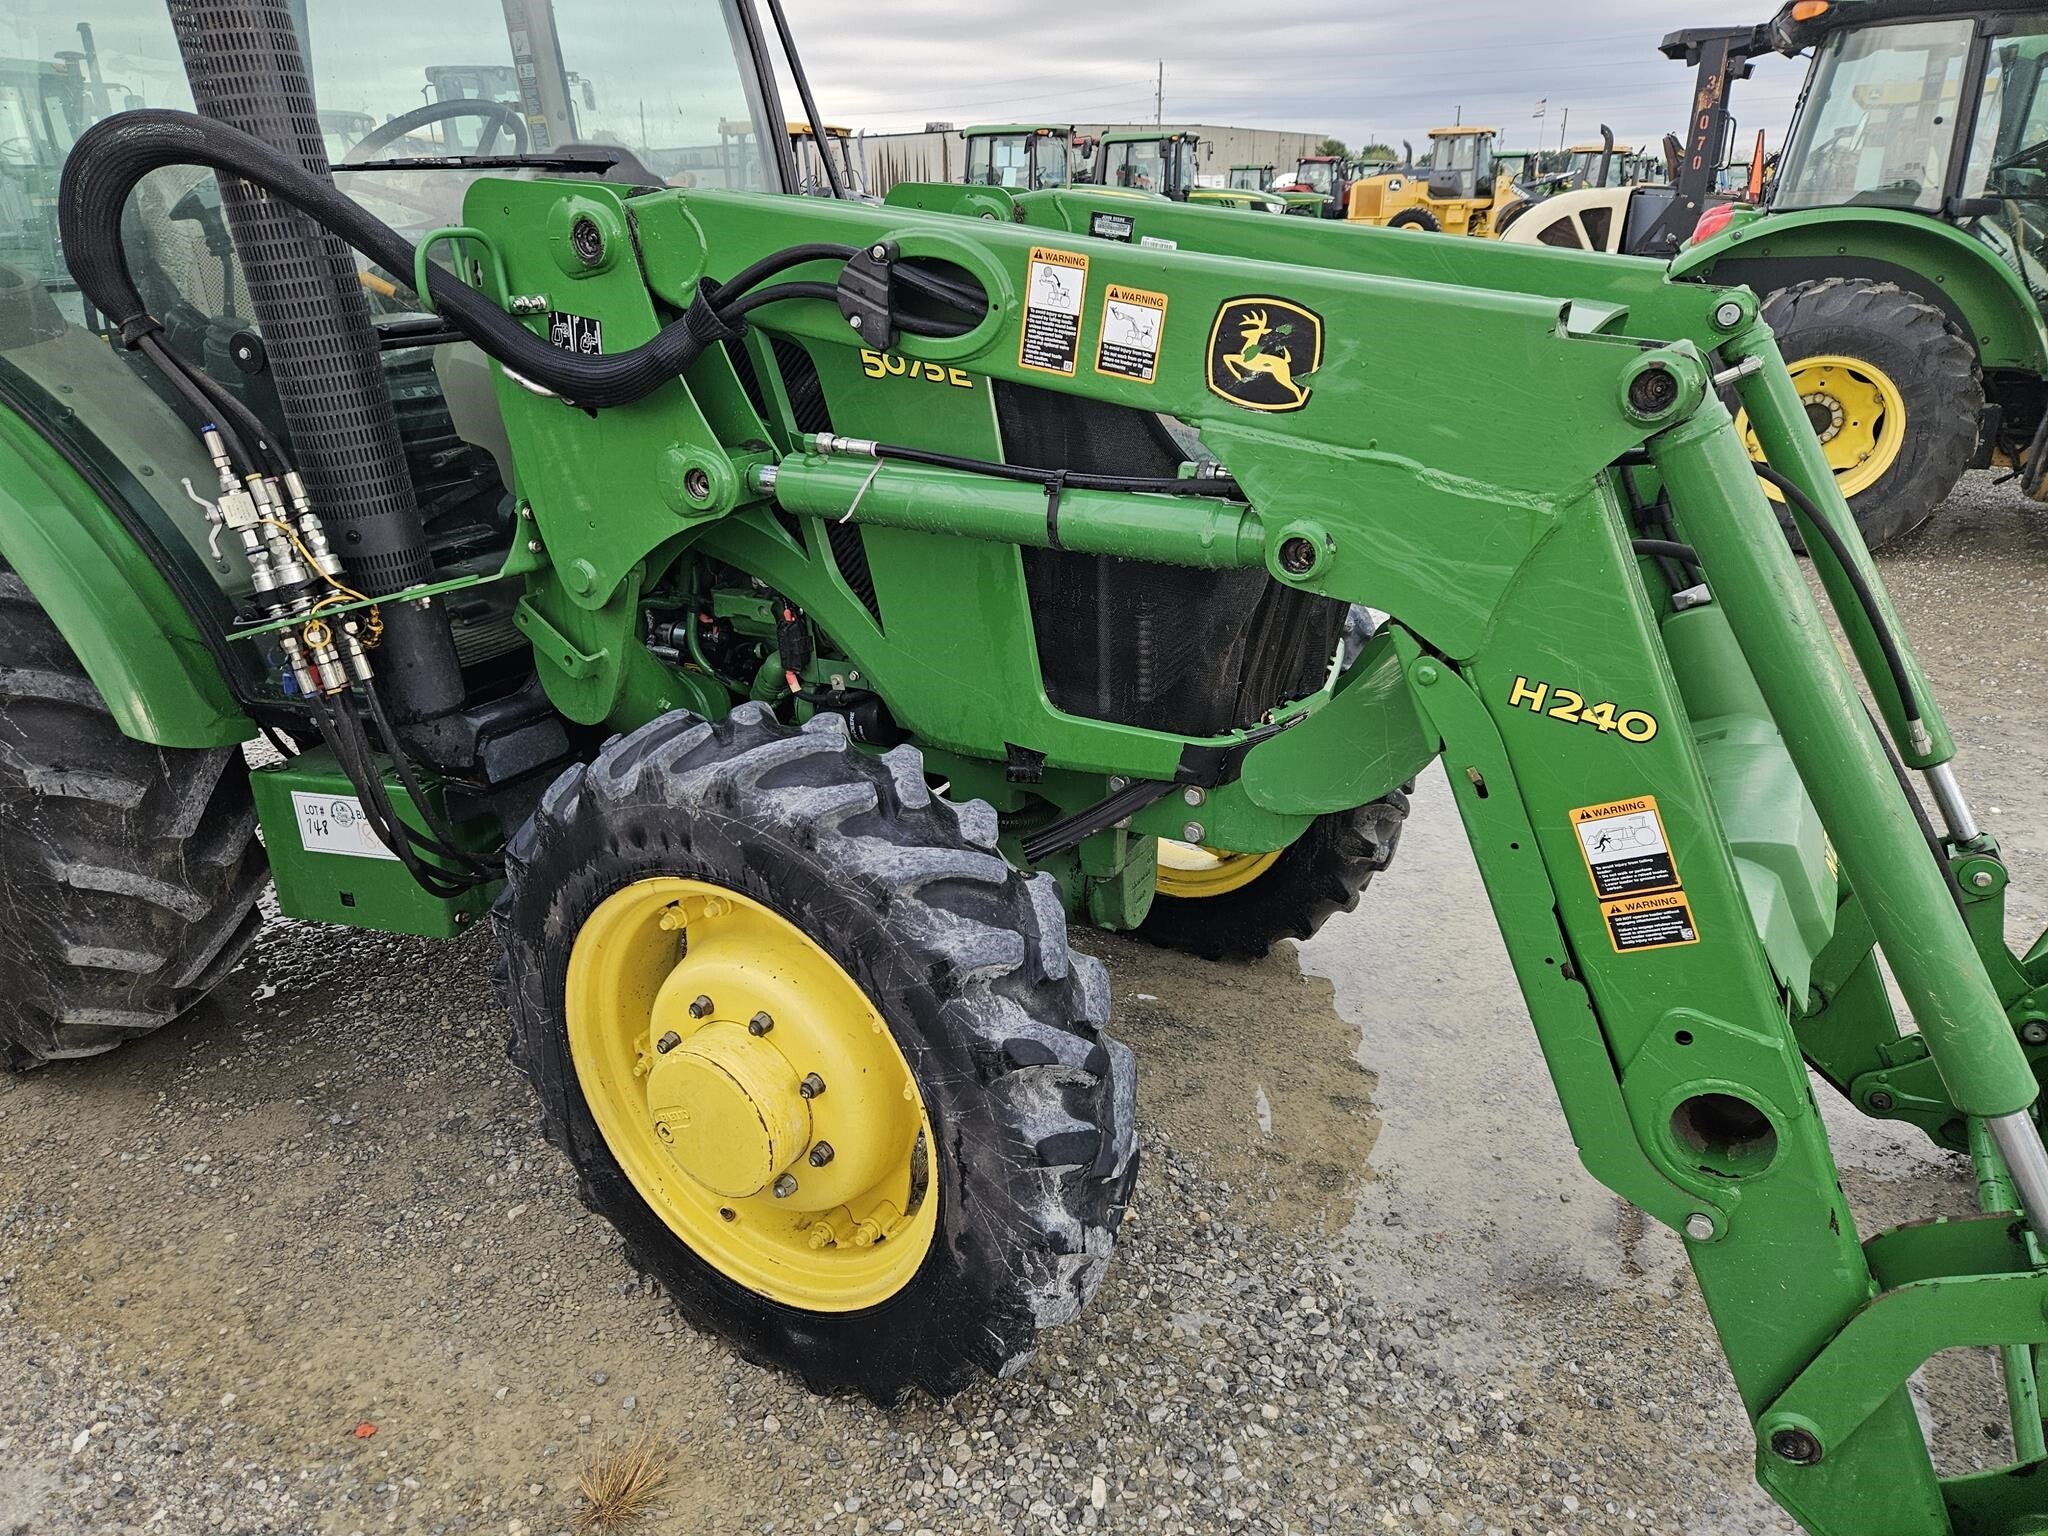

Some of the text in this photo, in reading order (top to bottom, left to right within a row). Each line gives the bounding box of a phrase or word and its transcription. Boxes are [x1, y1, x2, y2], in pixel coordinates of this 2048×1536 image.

[1045, 252, 1085, 266] WARNING
[1121, 292, 1163, 307] WARNING
[1507, 676, 1659, 742] H240
[1592, 801, 1646, 816] WARNING
[1625, 897, 1678, 911] WARNING
